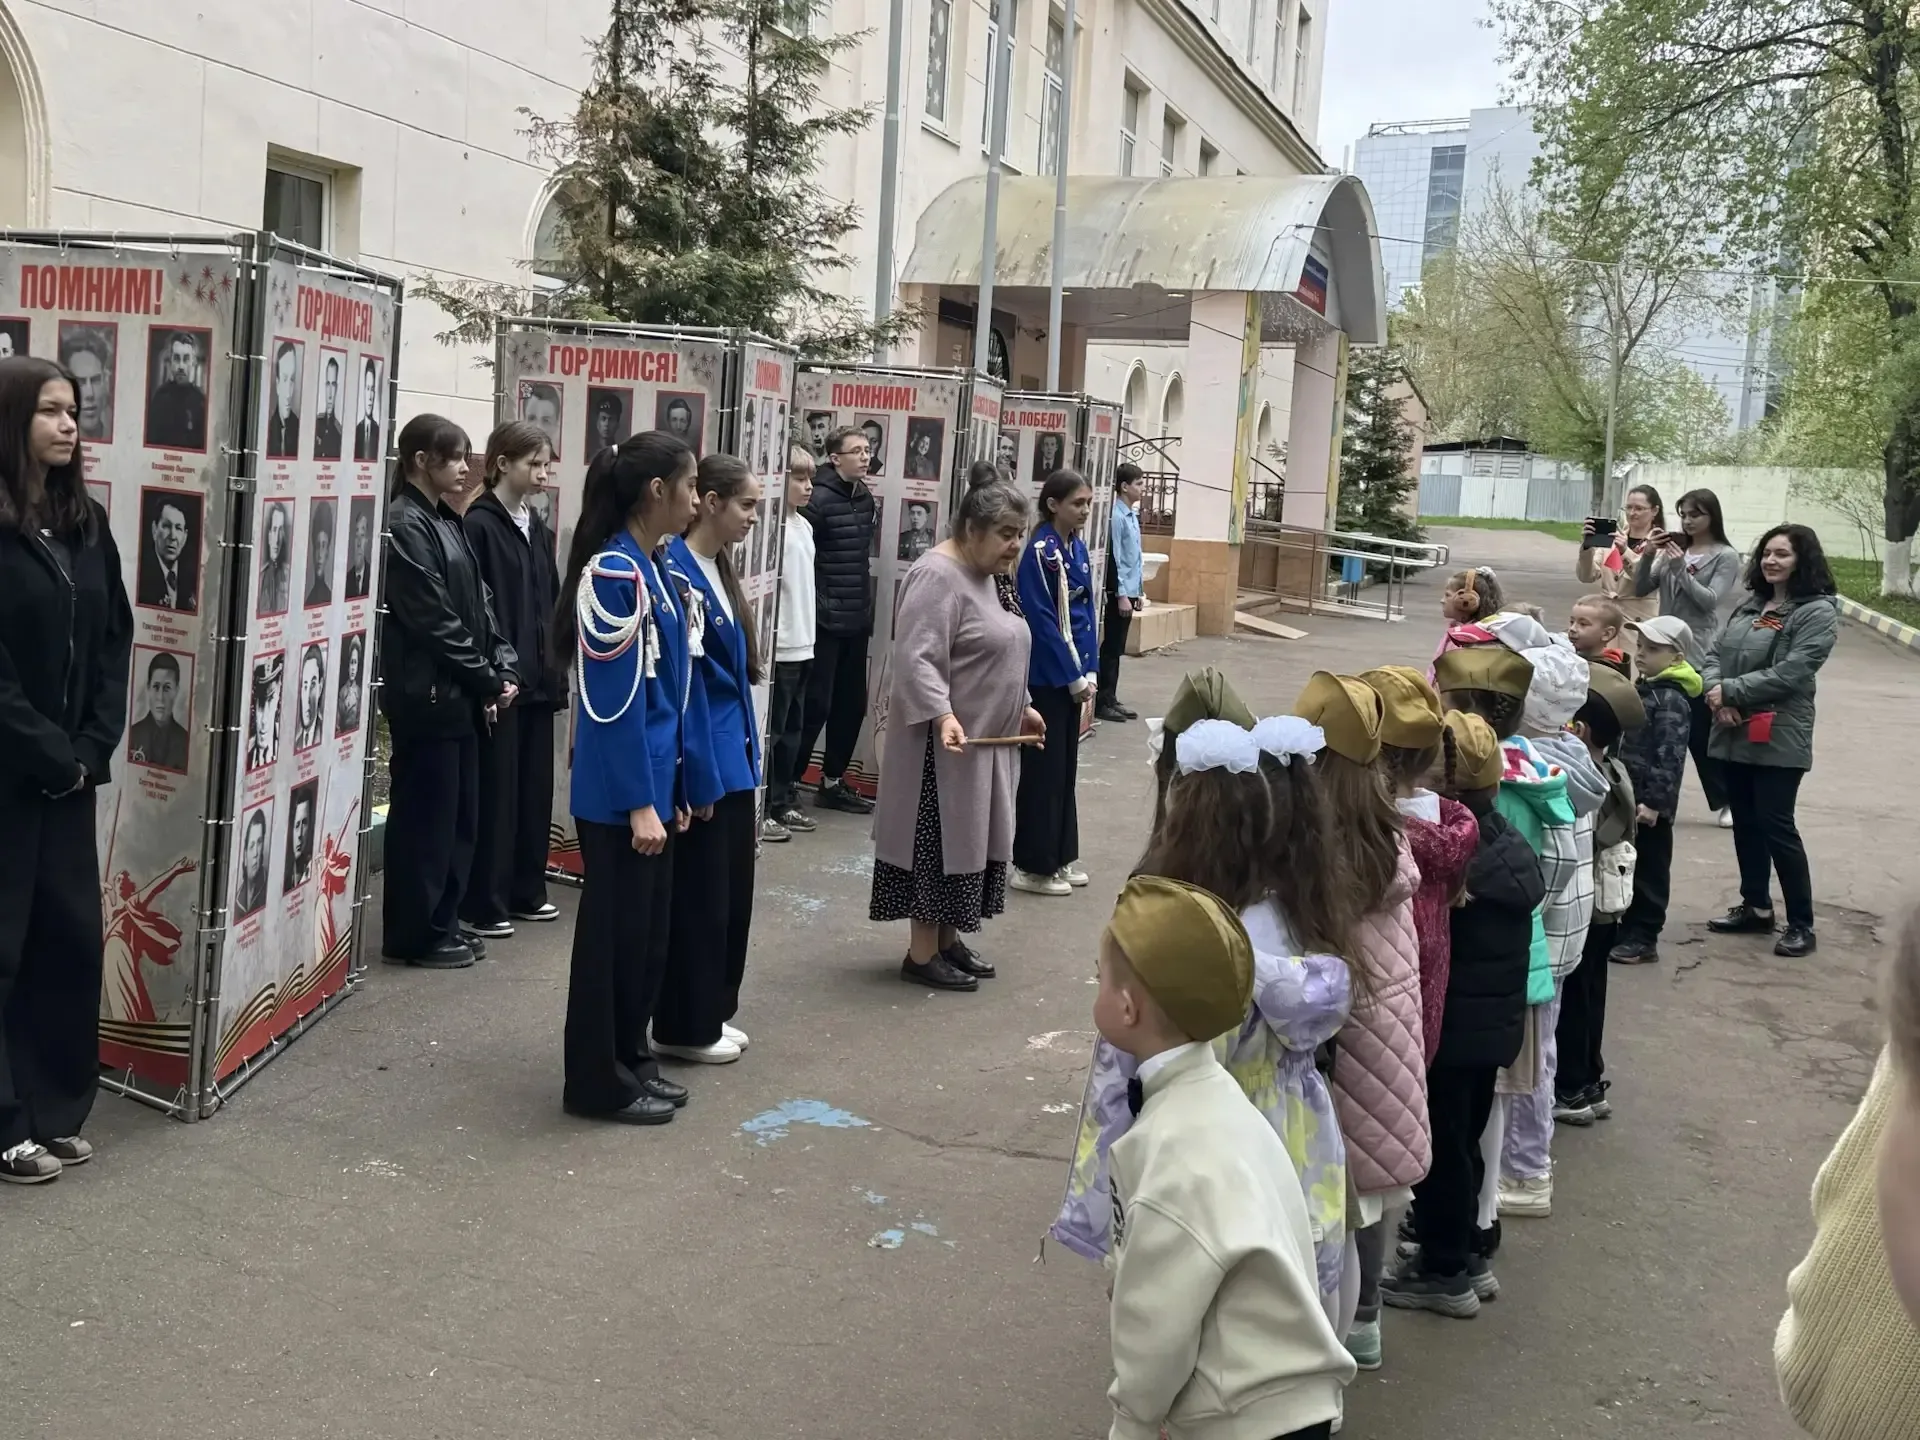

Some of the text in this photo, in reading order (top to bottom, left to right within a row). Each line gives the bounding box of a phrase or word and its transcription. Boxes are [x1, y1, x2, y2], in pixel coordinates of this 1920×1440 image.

[20, 265, 164, 315] ПОМНИМ!
[296, 285, 373, 344] ГОРДИМСЯ!
[549, 345, 679, 383] ГОРДИМСЯ!
[832, 384, 918, 411] ПОМНИМ!
[1002, 411, 1067, 431] ЗА ПОБЕДУ!
